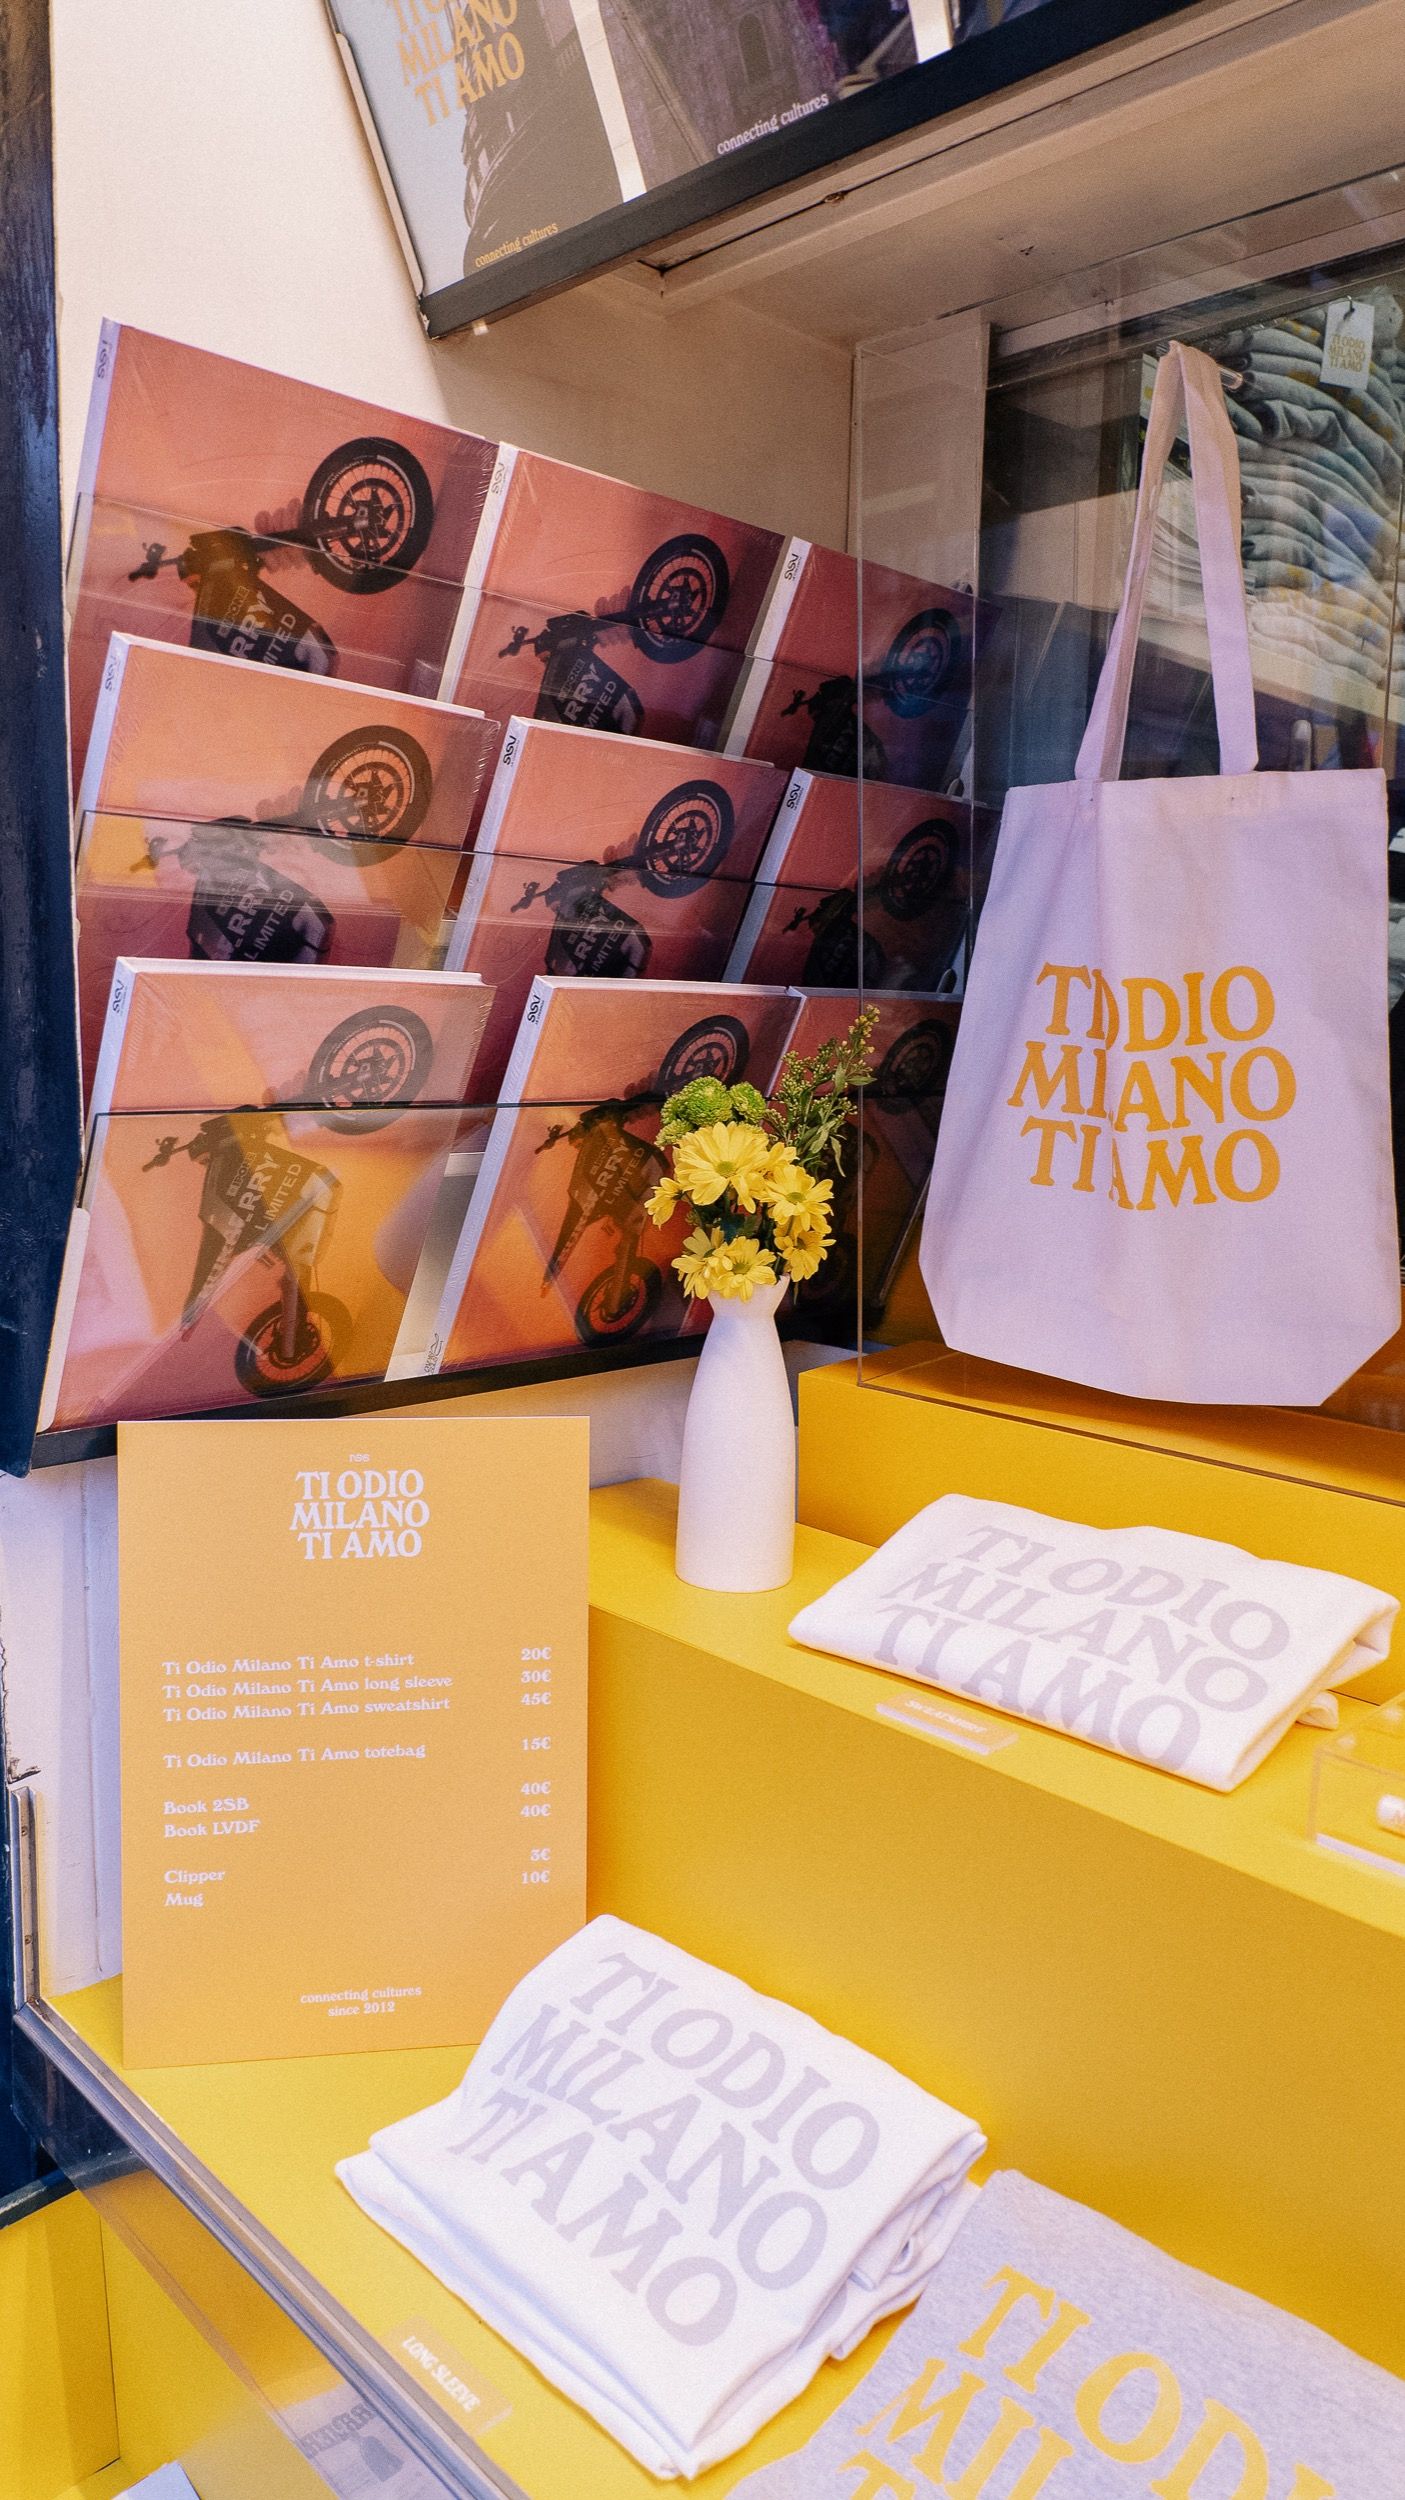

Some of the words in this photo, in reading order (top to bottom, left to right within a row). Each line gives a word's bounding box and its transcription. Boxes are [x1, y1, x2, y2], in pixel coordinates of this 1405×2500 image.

[396, 0, 518, 87] MILANO
[414, 75, 450, 127] TI
[455, 32, 525, 109] AMO
[716, 114, 780, 156] connecting
[780, 93, 830, 126] cultures
[475, 236, 522, 268] connecting
[522, 222, 559, 247] cultures
[227, 871, 272, 948] RRY
[244, 890, 294, 960] LIMITED
[574, 906, 610, 971] RRY
[591, 919, 625, 972] IMITED
[1036, 962, 1105, 1040] TI
[1006, 1041, 1296, 1132] MIANO
[238, 1151, 280, 1222] RRY
[596, 1138, 630, 1197] RRY
[604, 1147, 645, 1205] LIMITED
[1020, 1115, 1102, 1192] TI
[1108, 1129, 1281, 1211] AMO
[254, 1163, 302, 1231] LIMITED
[289, 1500, 430, 1532] MILANO
[295, 1470, 330, 1500] TI
[337, 1468, 425, 1500] ODIO
[296, 1531, 333, 1560] TI
[340, 1529, 423, 1559] AMO
[955, 1524, 1056, 1577] TI
[1049, 1557, 1290, 1662] ODIO
[160, 1660, 182, 1676] Ti
[185, 1659, 228, 1675] Odio
[231, 1657, 293, 1673] Milano
[296, 1654, 316, 1671] Ti
[319, 1655, 360, 1670] Amo
[363, 1652, 415, 1668] t-shirt
[520, 1645, 553, 1662] 20€
[880, 1562, 1268, 1712] MILANO
[161, 1683, 182, 1700] Ti
[186, 1683, 228, 1698] Odio
[232, 1681, 293, 1696] Milano
[296, 1678, 316, 1694] Ti
[320, 1678, 360, 1693] Amo
[364, 1677, 401, 1692] long
[404, 1675, 454, 1689] sleeve
[519, 1667, 552, 1684] 30€
[162, 1706, 183, 1723] Ti
[185, 1706, 229, 1722] Odio
[232, 1704, 294, 1720] Milano
[296, 1701, 317, 1717] Ti
[319, 1700, 361, 1716] Amo
[363, 1697, 451, 1714] sweatshirt
[519, 1690, 552, 1707] 45€
[874, 1603, 970, 1682] TI
[966, 1638, 1202, 1770] AMO
[162, 1753, 183, 1770] Ti
[185, 1752, 230, 1769] Odio
[232, 1749, 294, 1766] Milano
[296, 1746, 316, 1763] Ti
[320, 1745, 361, 1762] Amo
[363, 1743, 427, 1760] totebag
[521, 1735, 552, 1752] 15€
[162, 1799, 208, 1816] Book
[211, 1795, 251, 1813] 2SB
[519, 1779, 552, 1797] 40€
[163, 1822, 209, 1840] Book
[211, 1818, 262, 1836] LVDF
[519, 1802, 552, 1818] 40€
[163, 1868, 227, 1886] Clipper
[529, 1846, 551, 1863] 3€
[163, 1891, 206, 1909] Mug
[521, 1868, 551, 1886] 10€
[299, 1988, 369, 2003] connecting
[371, 1984, 423, 1999] cultures
[327, 2005, 360, 2017] since
[362, 2001, 396, 2015] 2012
[570, 1952, 680, 2036] TI
[650, 2008, 881, 2191] ODIO
[490, 2003, 830, 2292] MILANO
[446, 2087, 550, 2166] TI
[501, 2130, 739, 2347] AMO
[401, 2334, 438, 2374] LONG
[431, 2363, 482, 2414] SLEEVE
[957, 2264, 1092, 2395] TI
[1074, 2351, 1337, 2500] OD
[854, 2357, 1075, 2500] MI
